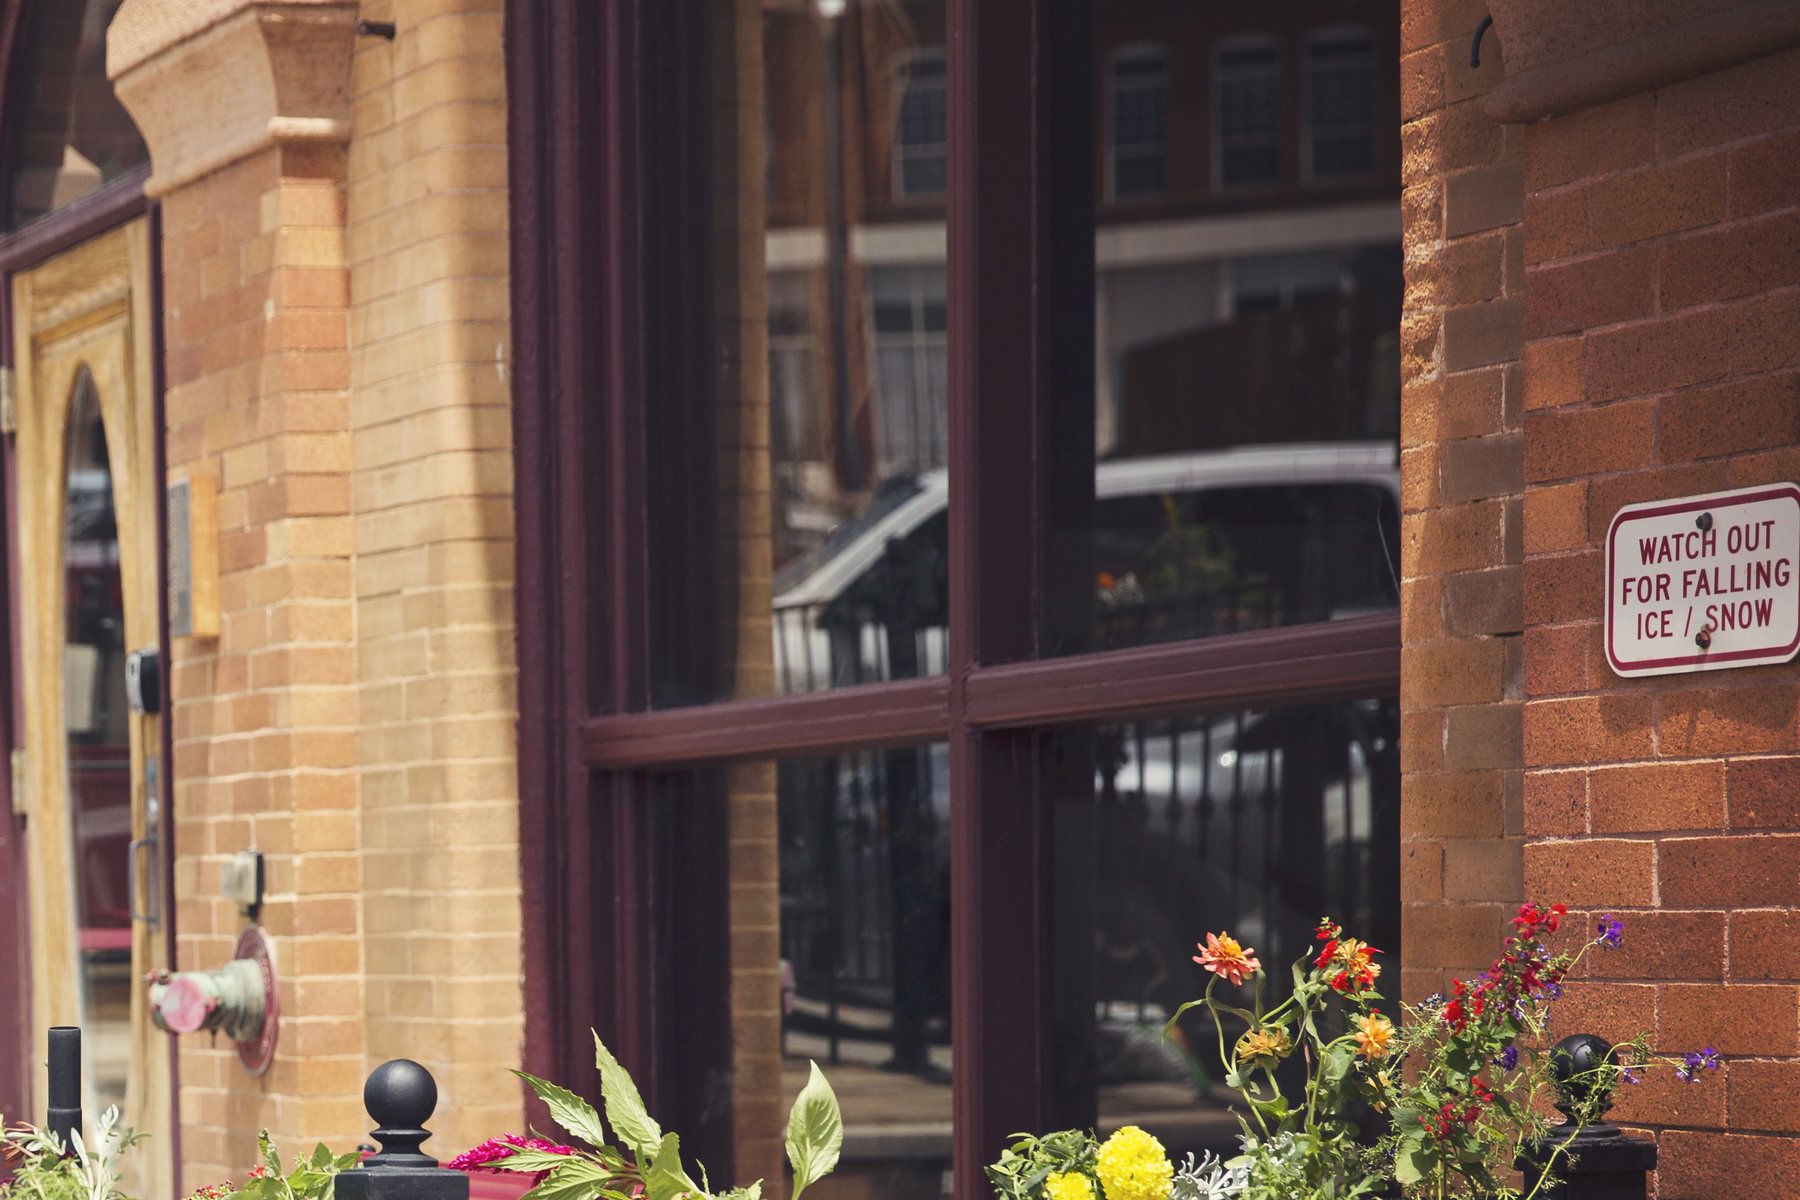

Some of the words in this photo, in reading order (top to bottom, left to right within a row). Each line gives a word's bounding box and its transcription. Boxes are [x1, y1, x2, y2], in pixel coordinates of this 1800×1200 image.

[1639, 528, 1717, 565] WATCH
[1727, 520, 1775, 554] OUT
[1622, 573, 1671, 605] FOR
[1682, 558, 1790, 599] FALLING
[1637, 610, 1673, 640] ICE
[1684, 606, 1693, 637] /
[1705, 598, 1773, 634] SNOW
